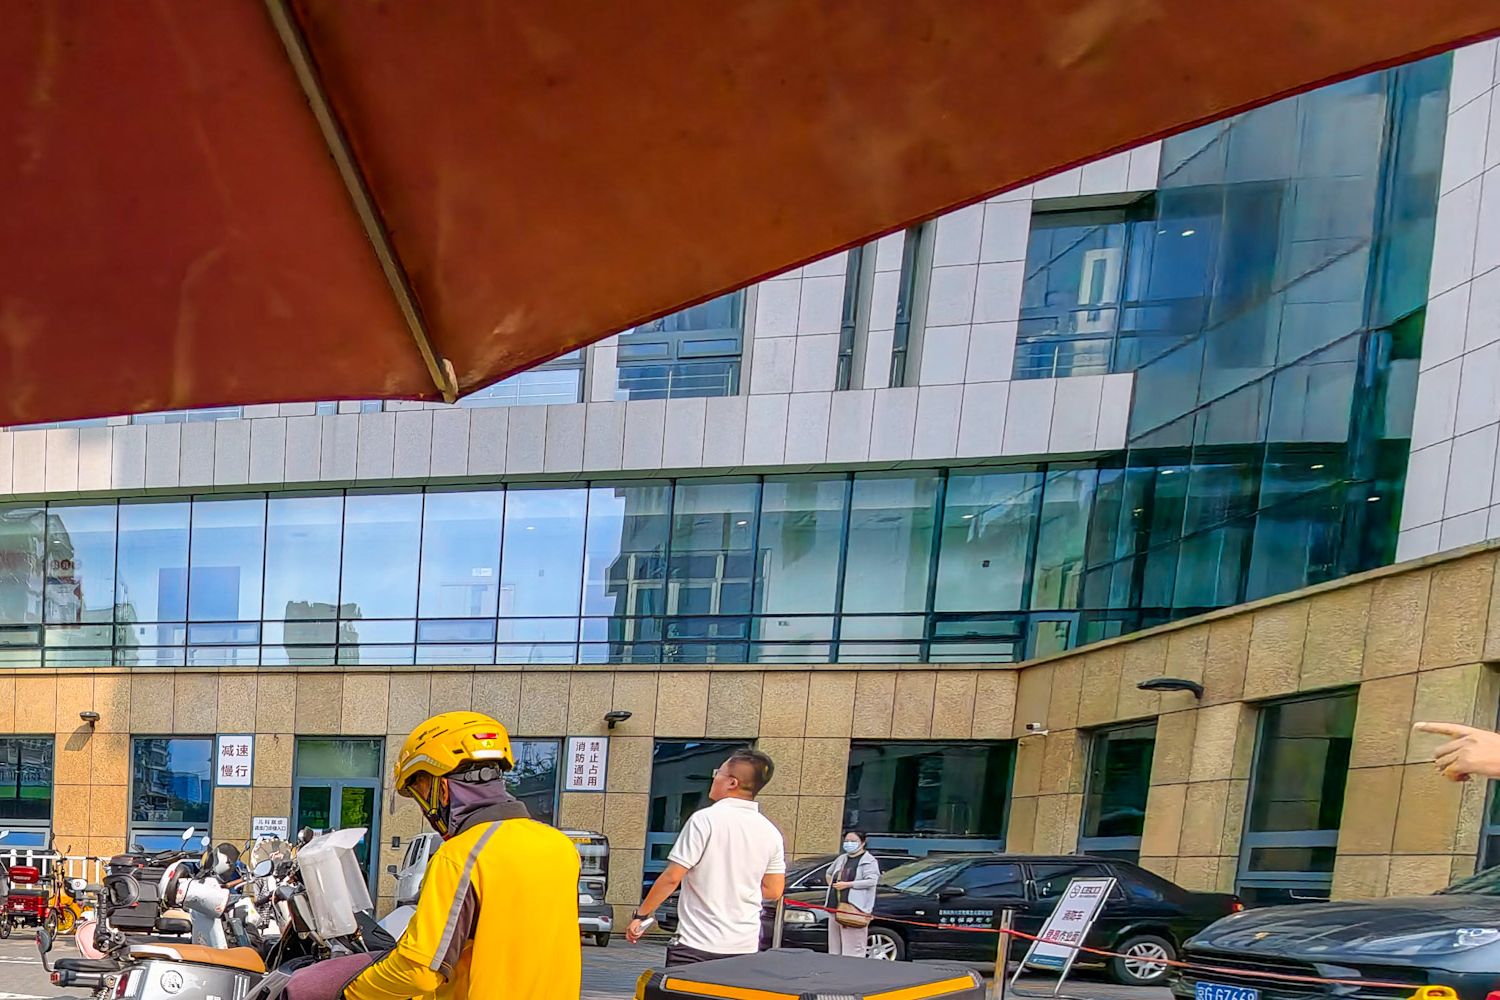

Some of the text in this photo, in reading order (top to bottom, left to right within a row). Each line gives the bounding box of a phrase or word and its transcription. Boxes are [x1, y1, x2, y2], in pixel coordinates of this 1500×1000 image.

[221, 744, 249, 757] 减速
[573, 741, 586, 786] 消防通道
[587, 741, 600, 786] 禁止占用
[220, 764, 248, 777] 慢行
